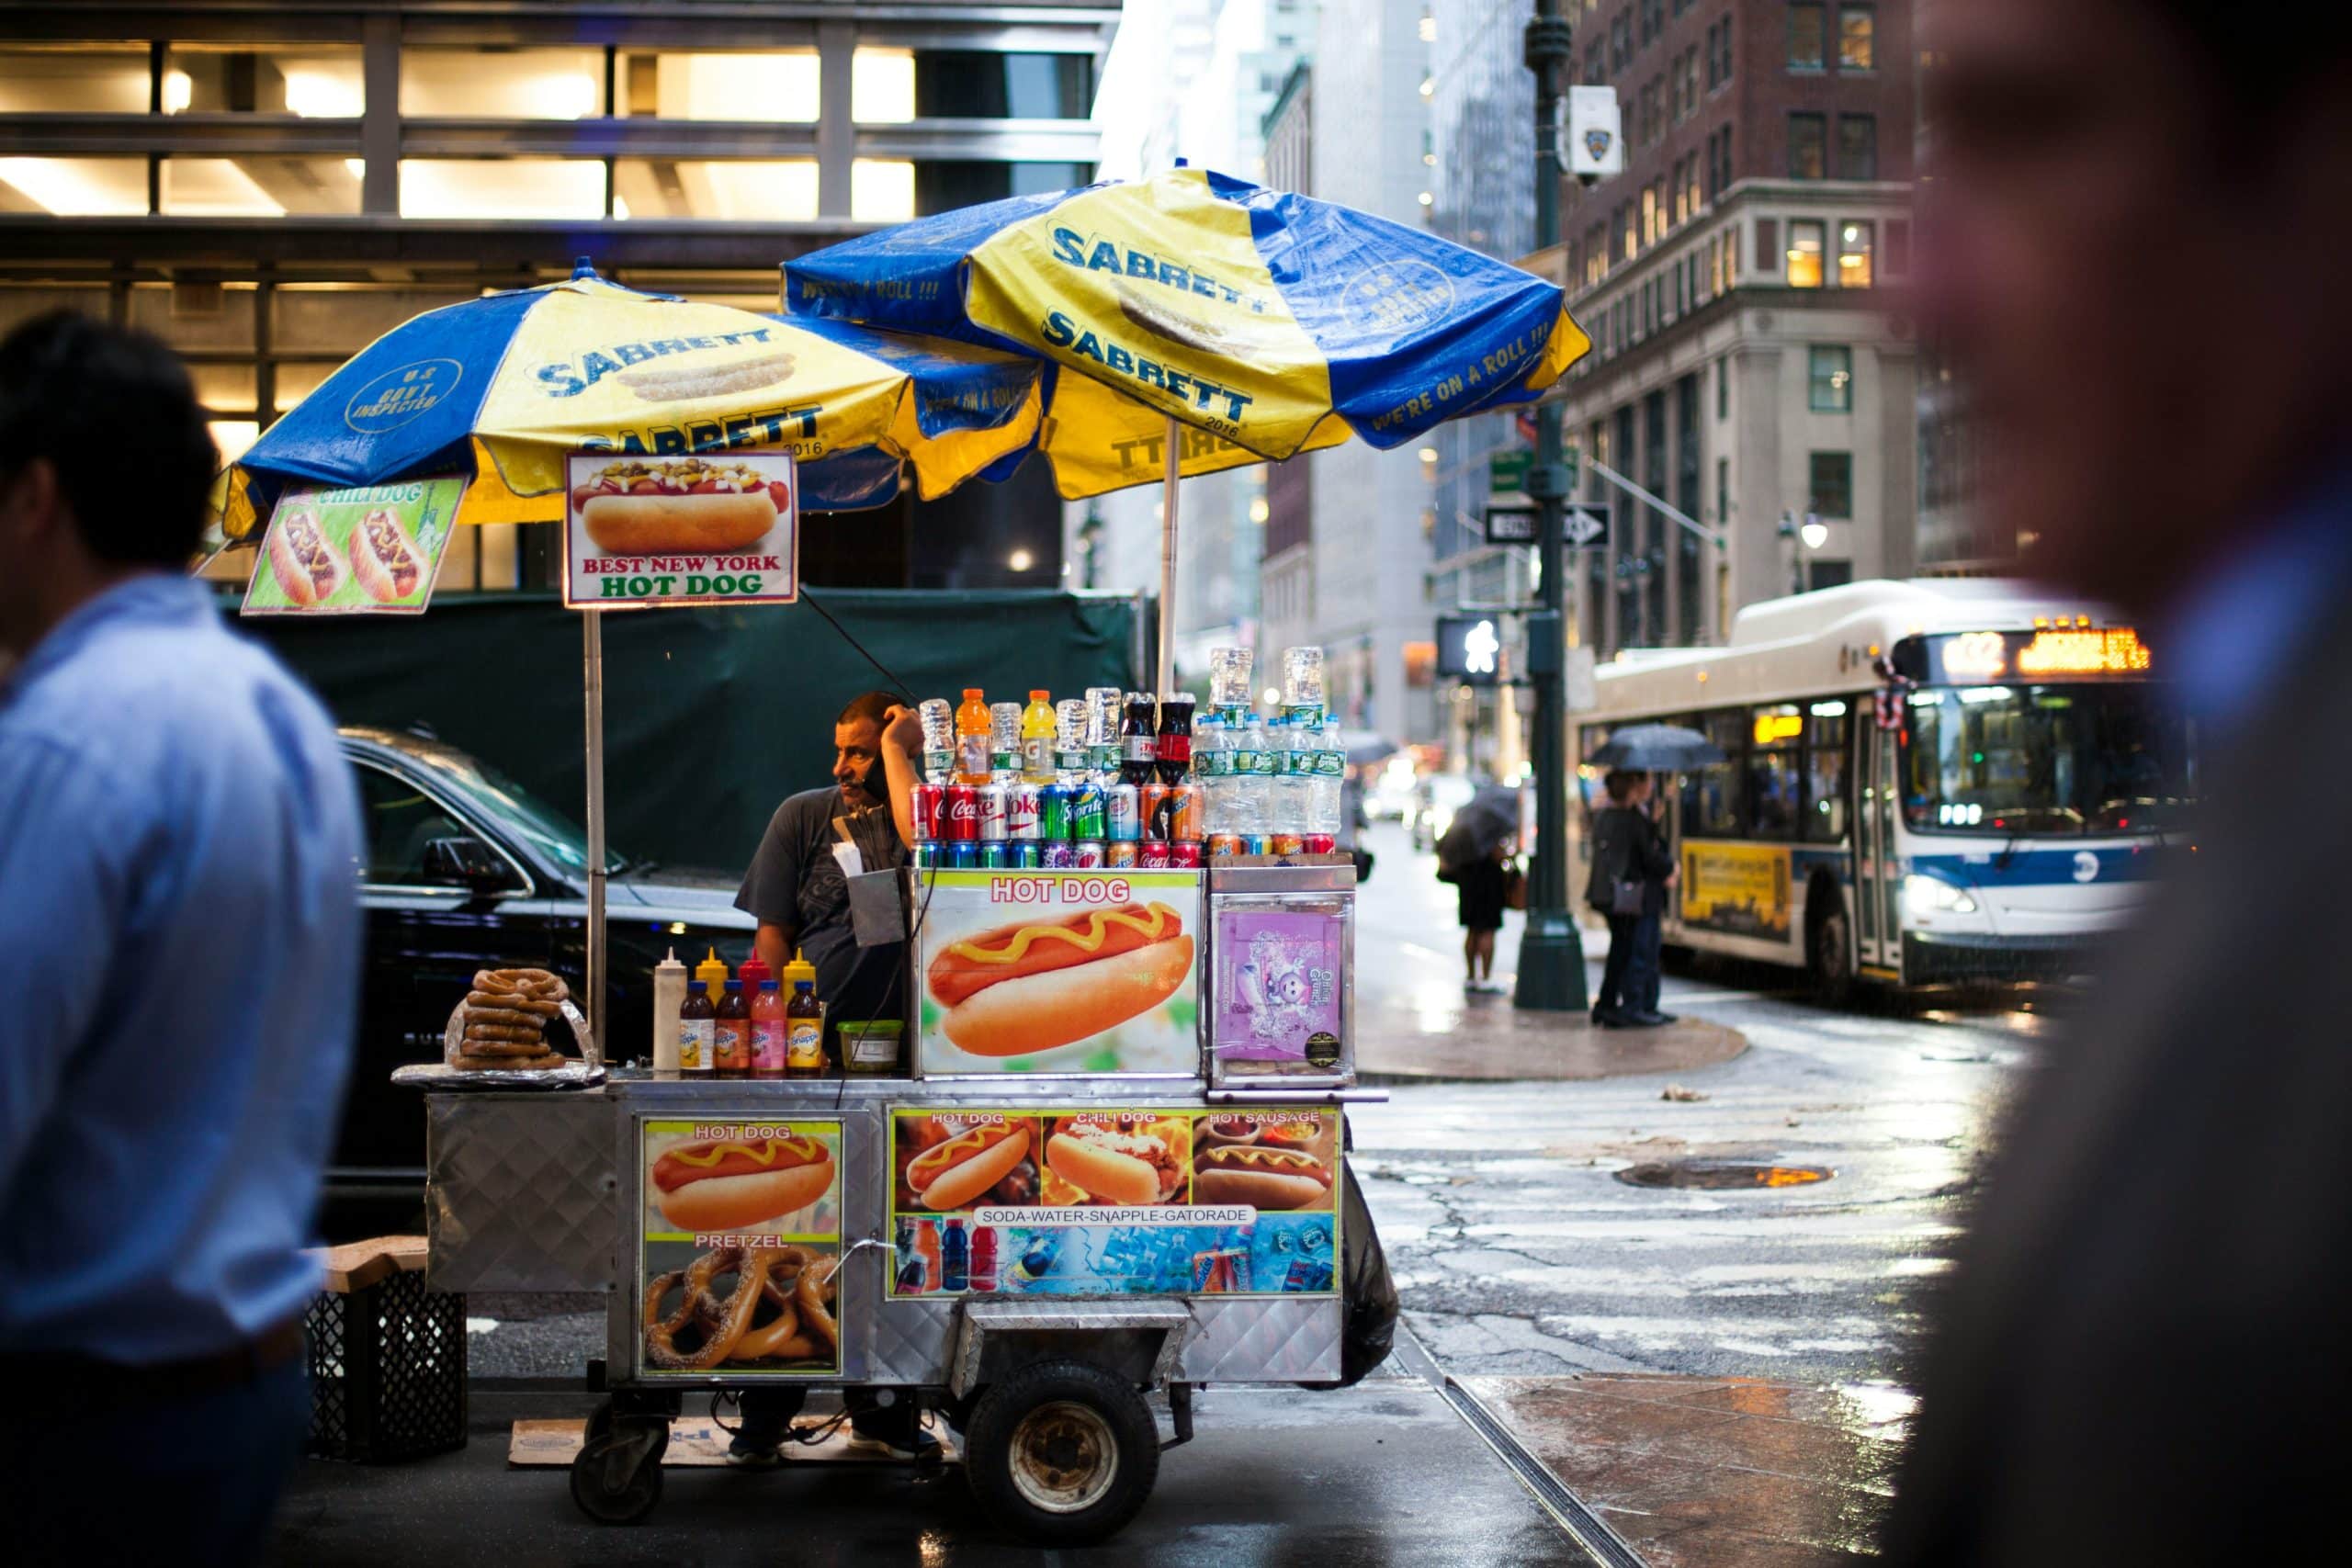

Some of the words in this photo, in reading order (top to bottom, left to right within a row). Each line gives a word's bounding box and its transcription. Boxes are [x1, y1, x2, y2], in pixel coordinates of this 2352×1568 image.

[1053, 226, 1267, 314] SABRETT
[537, 328, 770, 398] SABRETT
[1041, 310, 1253, 423] SABRETT
[1437, 374, 1464, 401] ON
[1469, 366, 1482, 385] A
[1483, 337, 1527, 376] ROLL
[1204, 416, 1239, 437] 2016
[375, 483, 422, 503] DOG
[583, 558, 643, 574] BEST
[651, 558, 707, 573] NEW
[713, 556, 780, 571] YORK
[601, 577, 676, 597] HOT
[685, 575, 763, 595] DOG
[991, 877, 1055, 902] HOT
[1061, 877, 1130, 902] DOG
[932, 1113, 964, 1123] HOT
[969, 1113, 1004, 1123] DOG
[1077, 1112, 1117, 1123] CHILI
[1122, 1112, 1156, 1122] DOG
[1209, 1113, 1240, 1123] HOT
[1246, 1111, 1319, 1122] SAUSAGE
[695, 1126, 738, 1139] HOT
[744, 1126, 790, 1139] DOG
[982, 1209, 1248, 1224] SODA-WATER-SNAPPLE-GATORADE
[695, 1235, 788, 1247] PRETZEL
